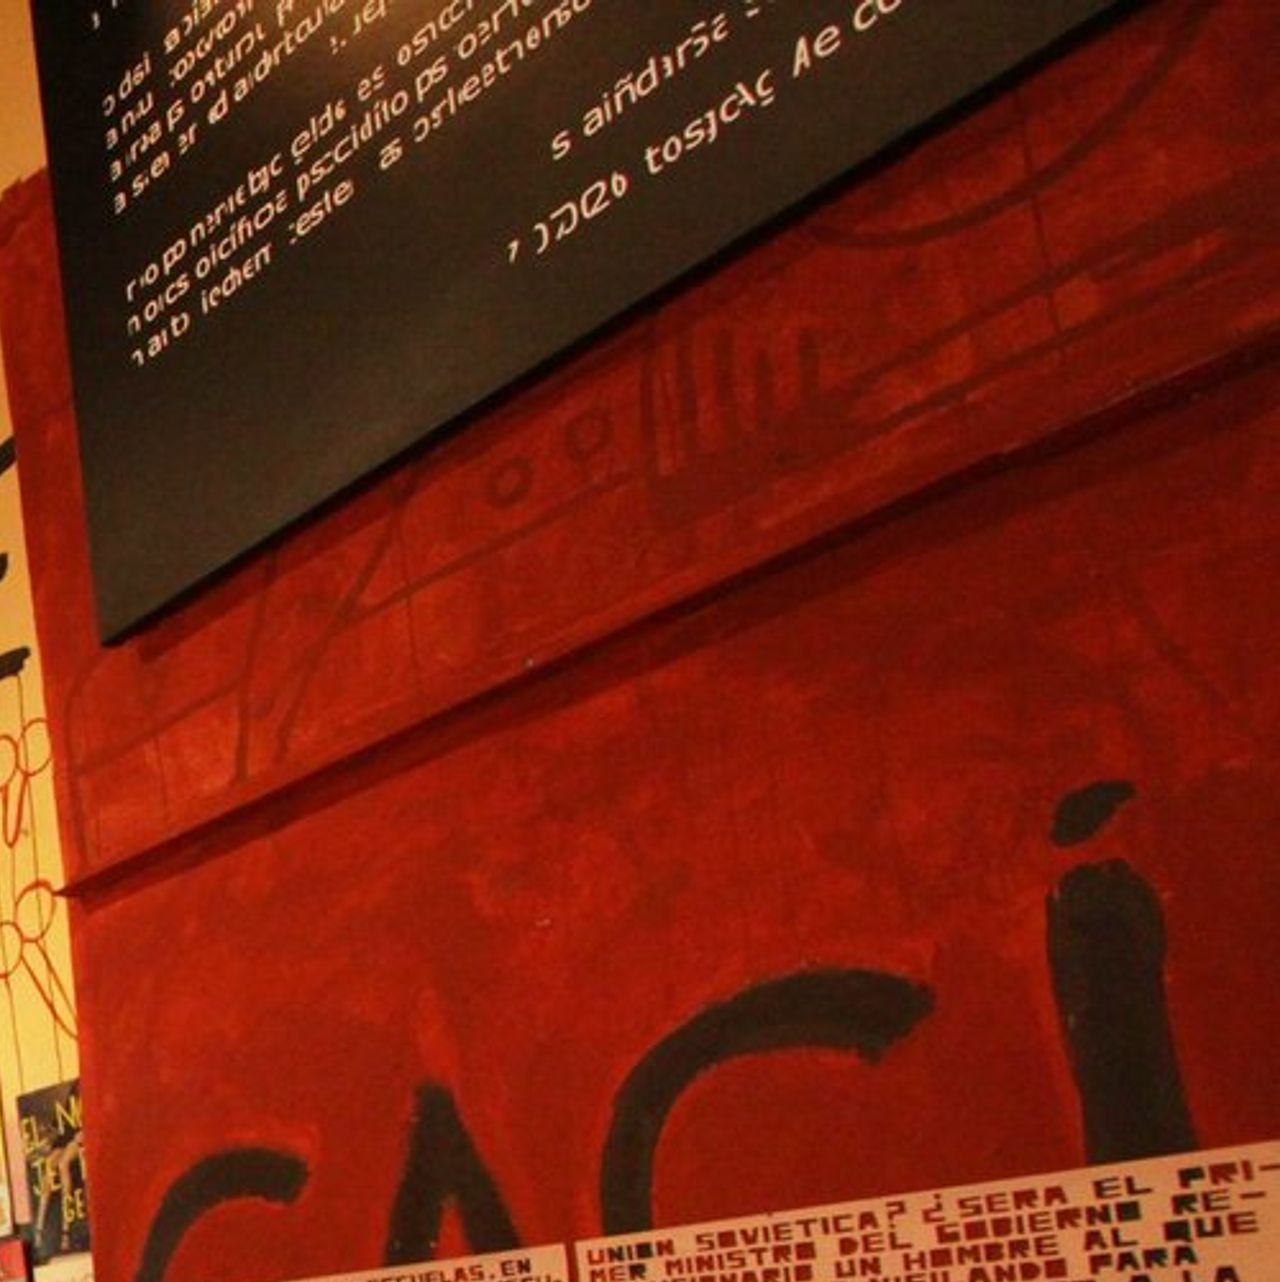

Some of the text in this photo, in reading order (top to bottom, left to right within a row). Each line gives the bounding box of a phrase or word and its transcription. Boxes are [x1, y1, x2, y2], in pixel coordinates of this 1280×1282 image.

[586, 1238, 674, 1266] UNION
[1092, 1172, 1152, 1200] EL
[664, 1240, 816, 1276] MINISTRO
[838, 1228, 912, 1256] DEL
[935, 1199, 1140, 1244] GOBIERNO
[834, 1255, 881, 1279] UN
[902, 1234, 1057, 1271] HOMBRE
[1082, 1224, 1136, 1251] AL
[1162, 1210, 1258, 1245] QUE
[1088, 1243, 1197, 1274] PARA
